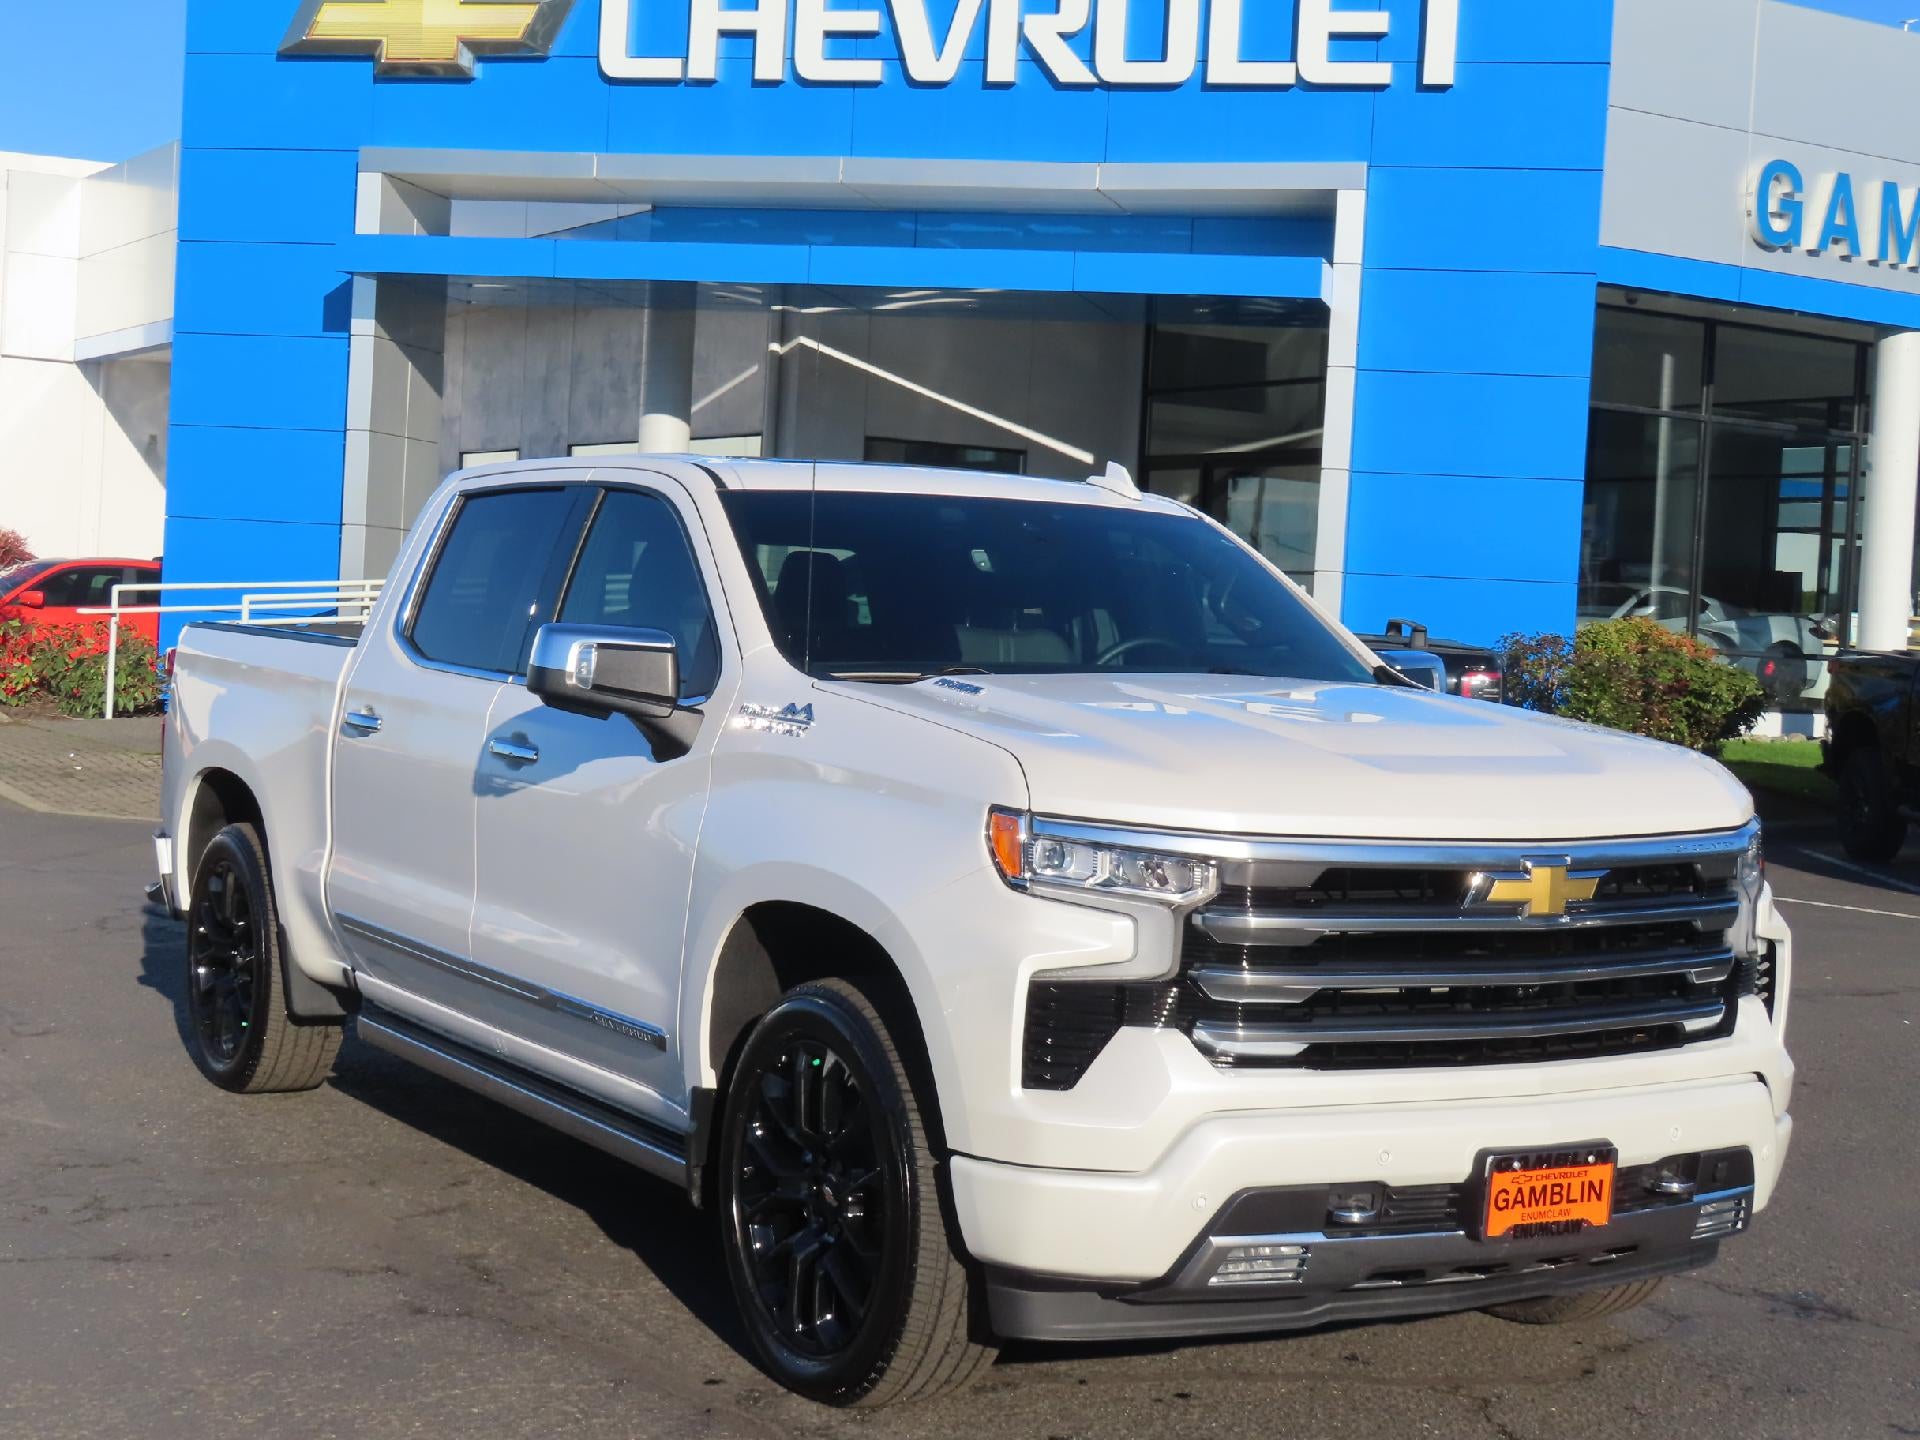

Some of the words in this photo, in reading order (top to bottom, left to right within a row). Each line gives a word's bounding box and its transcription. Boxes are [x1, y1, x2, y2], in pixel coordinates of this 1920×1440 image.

[1754, 158, 1920, 266] GAM
[1535, 1169, 1589, 1182] CHEVROLET
[1493, 1179, 1604, 1212] GAMBLIN
[1520, 1207, 1572, 1222] ENUMCLAW
